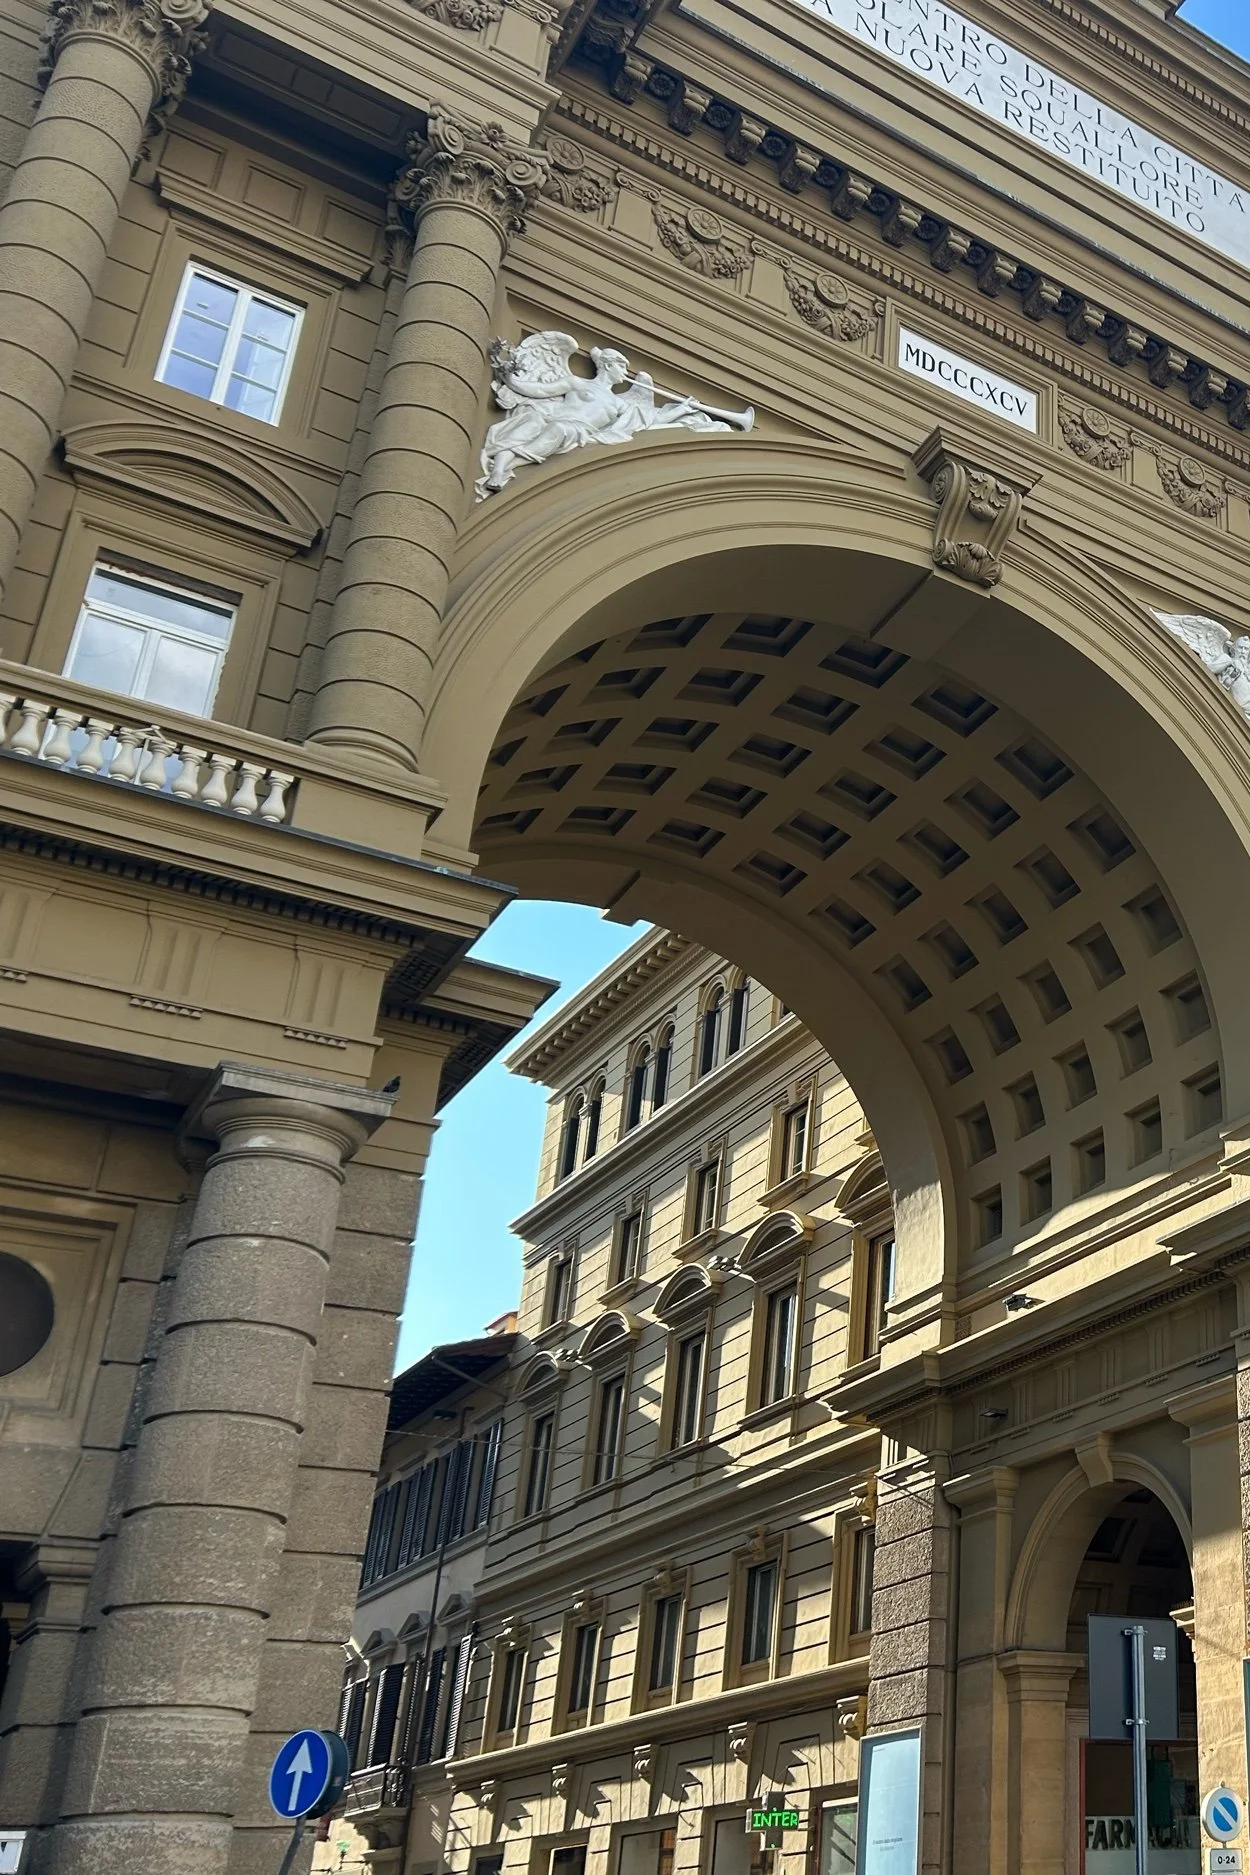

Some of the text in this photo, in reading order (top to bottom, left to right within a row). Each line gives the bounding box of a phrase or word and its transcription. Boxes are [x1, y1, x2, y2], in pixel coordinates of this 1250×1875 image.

[854, 12, 985, 105] NUOVA
[1003, 101, 1206, 232] RESTITUITO
[897, 0, 1008, 65] NTRO
[1025, 63, 1138, 149] DELLA
[999, 74, 1204, 210] SQUALLORE
[905, 343, 1027, 416] MDCCCXCV
[752, 1811, 798, 1828] INTER
[1217, 1855, 1236, 1865] 0-24
